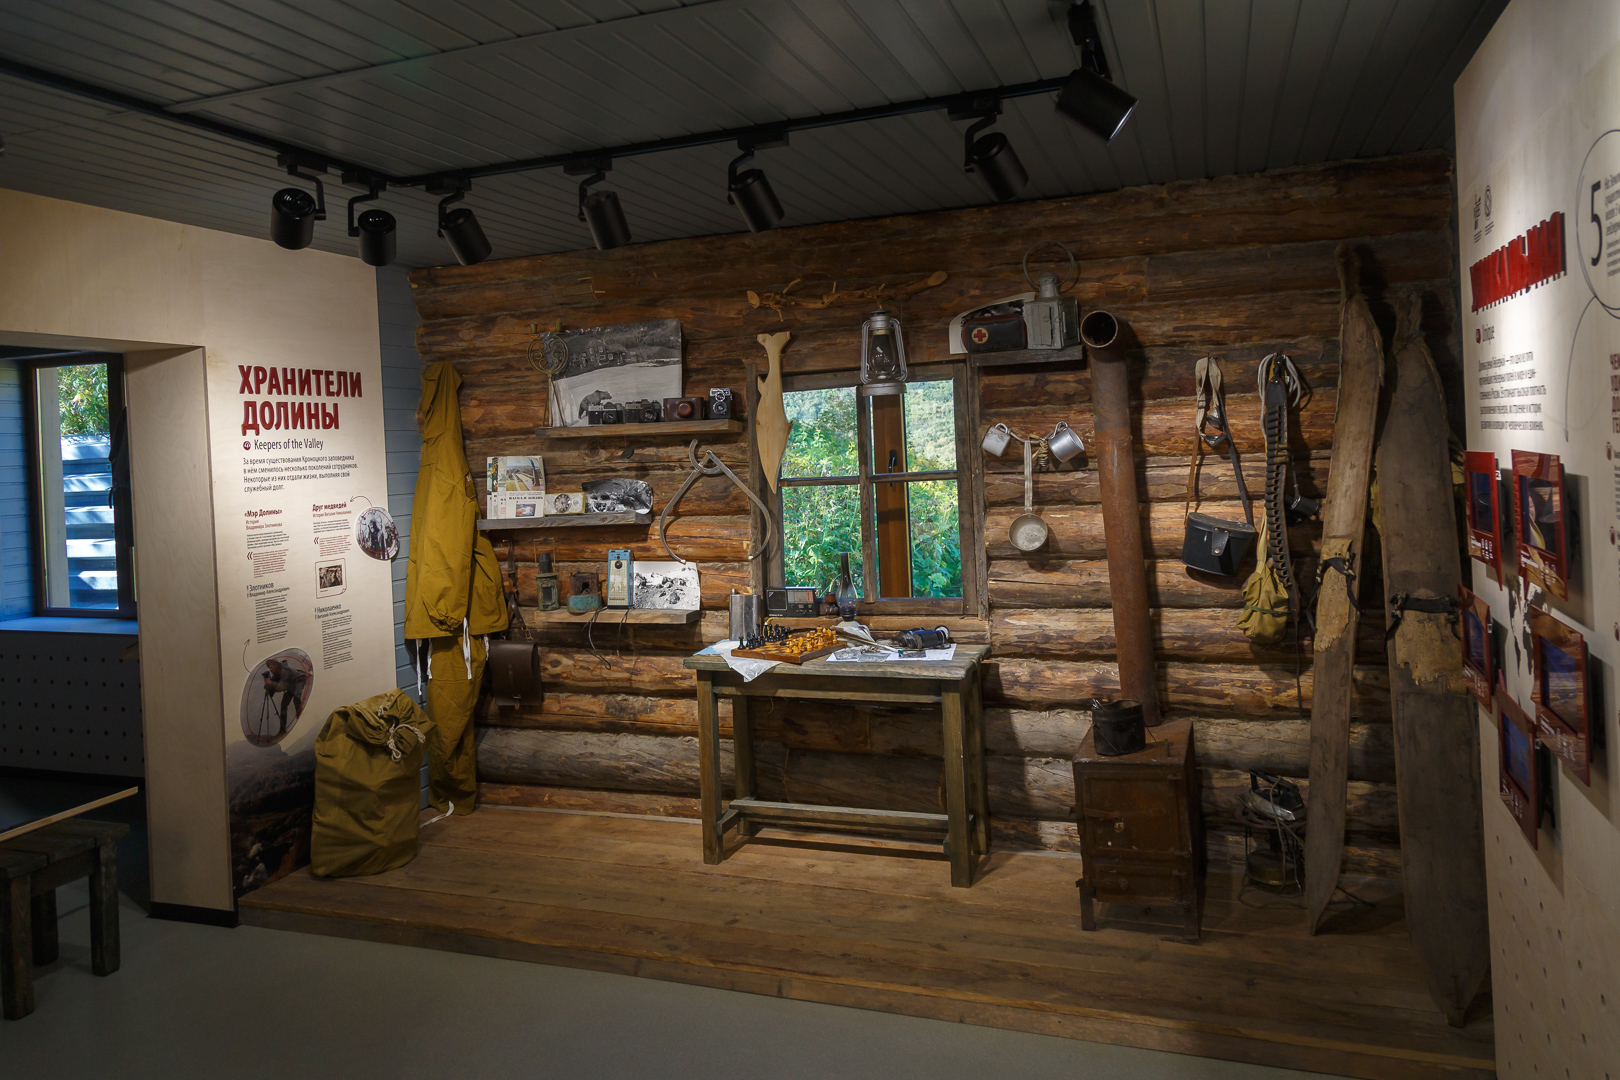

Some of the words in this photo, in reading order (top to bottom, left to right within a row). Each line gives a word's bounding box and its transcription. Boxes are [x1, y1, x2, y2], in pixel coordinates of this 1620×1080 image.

[1591, 180, 1603, 267] 5
[238, 365, 362, 398] ХРАНИТЕЛИ
[241, 401, 339, 436] ДОЛИНЫ
[254, 439, 282, 452] Keepers
[283, 438, 291, 449] of
[292, 439, 303, 449] the
[303, 438, 324, 451] Valley
[249, 458, 265, 466] время
[266, 456, 301, 465] существования
[302, 455, 327, 464] Кроноцкого
[243, 475, 270, 485] Некоторые
[277, 474, 286, 482] них
[244, 484, 272, 493] служебный
